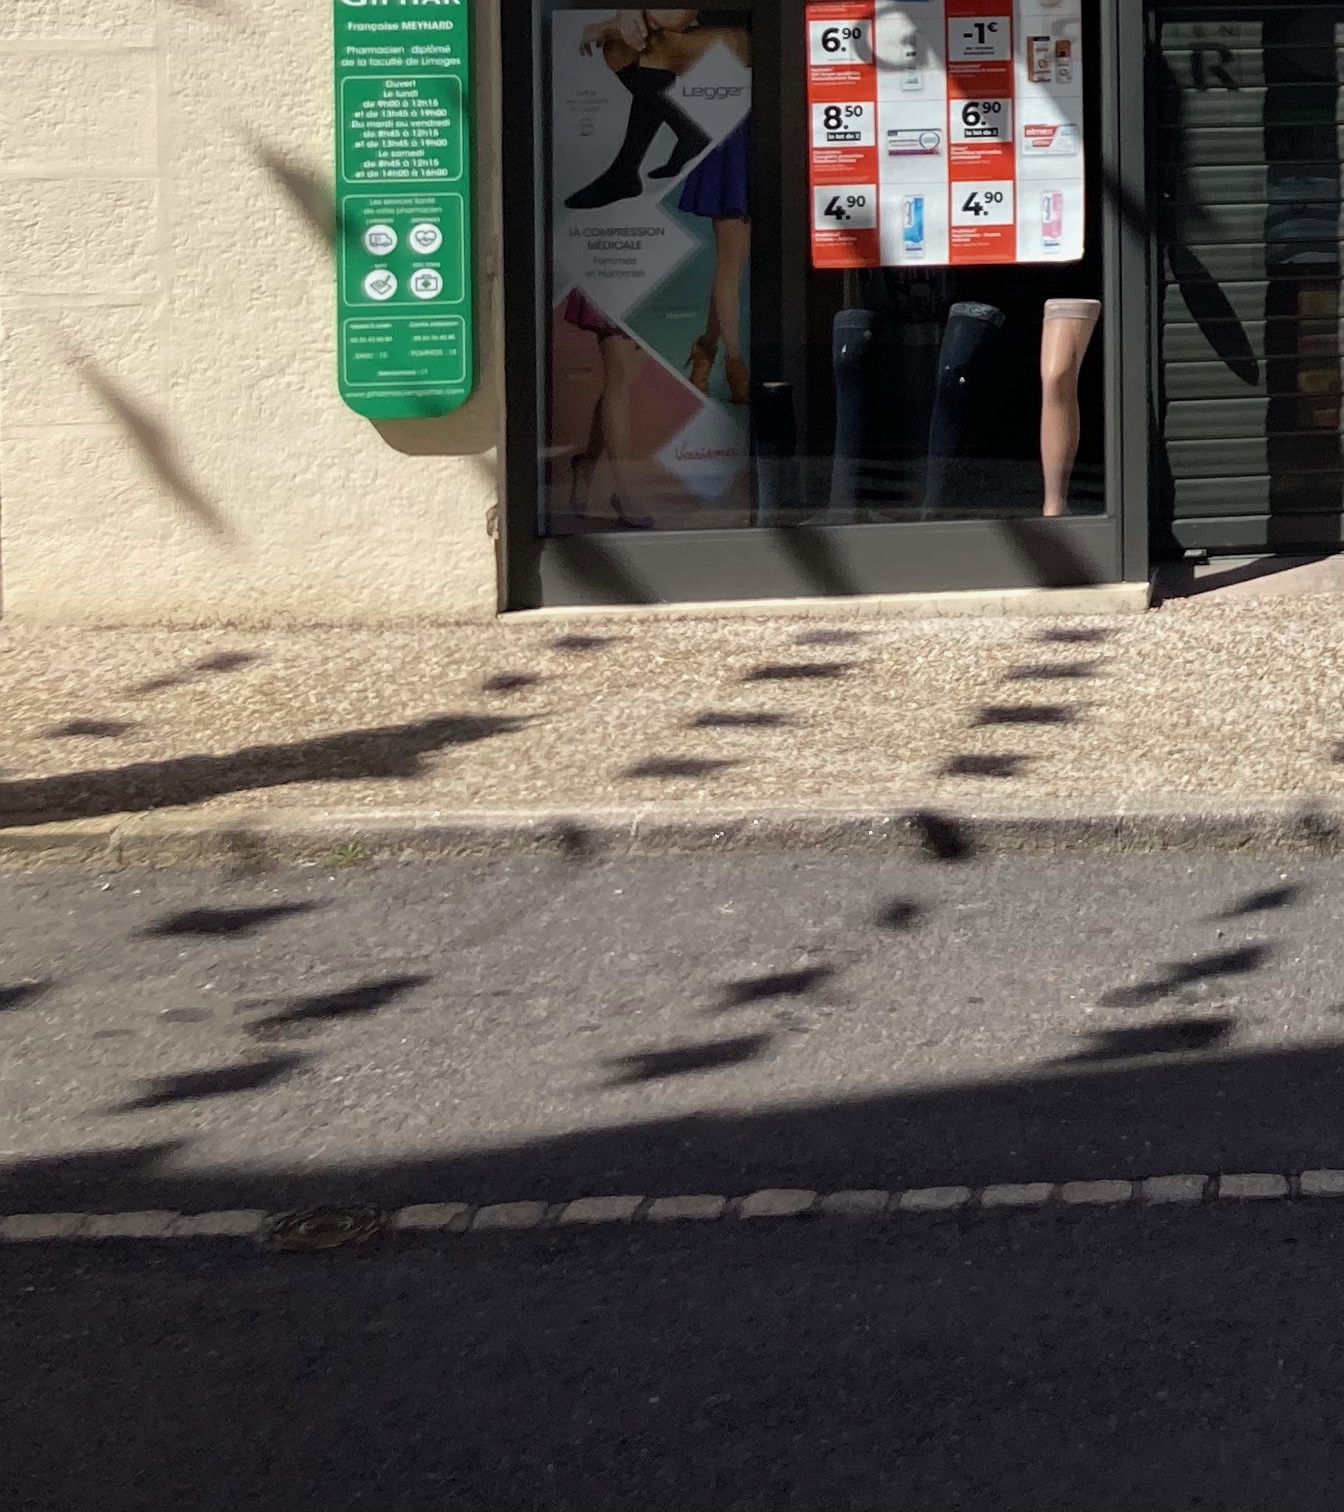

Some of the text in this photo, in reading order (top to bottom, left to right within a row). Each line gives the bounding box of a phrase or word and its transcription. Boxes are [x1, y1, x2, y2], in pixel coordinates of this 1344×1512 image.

[347, 20, 454, 32] Françoise MEYNARD
[346, 46, 405, 55] Pharmacien
[357, 58, 367, 66] la
[369, 57, 403, 66] faculté
[405, 57, 419, 66] de
[421, 57, 461, 67] Limoges
[384, 79, 416, 88] Ouvert
[383, 89, 419, 98] Le lundi
[682, 85, 742, 100] Legger
[362, 100, 375, 108] de
[366, 110, 379, 118] de
[351, 120, 365, 128] Du
[366, 119, 394, 128] mardi
[410, 118, 451, 127] vendredi
[363, 130, 376, 138] de
[366, 140, 379, 148] de
[378, 148, 425, 158] Le samedi
[363, 160, 376, 168] de
[366, 170, 379, 178] de
[569, 227, 665, 237] LA COMPRESSION
[592, 255, 638, 265] Femmes
